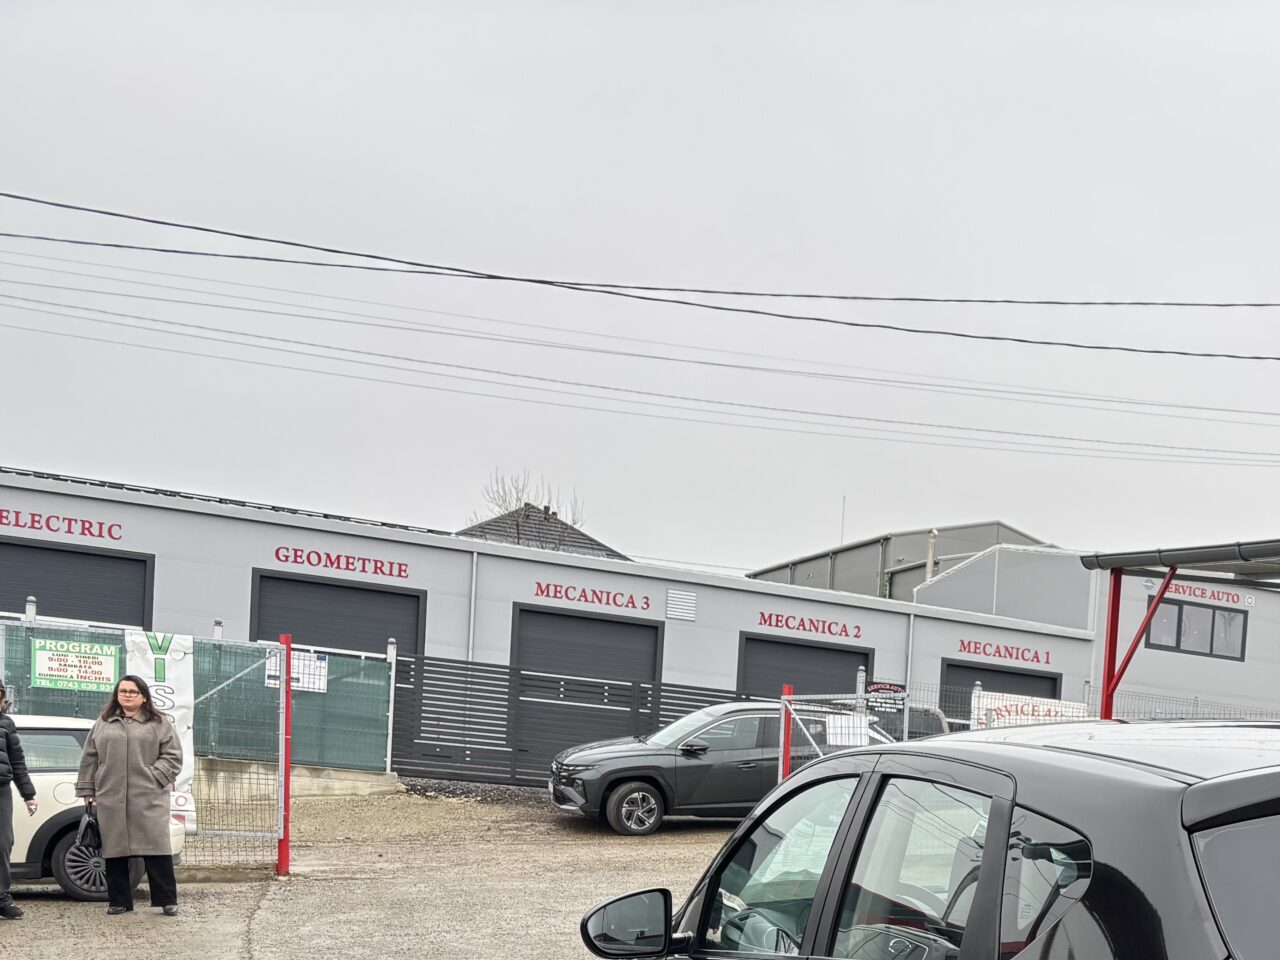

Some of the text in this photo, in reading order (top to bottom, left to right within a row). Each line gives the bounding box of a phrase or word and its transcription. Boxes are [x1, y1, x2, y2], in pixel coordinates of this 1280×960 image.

[0, 508, 123, 541] ELECTRIC
[274, 546, 409, 579] GEOMETRIE
[534, 581, 651, 611] MECANICA 3
[1165, 582, 1241, 604] ERVICE AUTO
[758, 611, 862, 639] MECANICA 2
[35, 639, 115, 656] PROGRAM
[958, 639, 1051, 665] MECANICA 1
